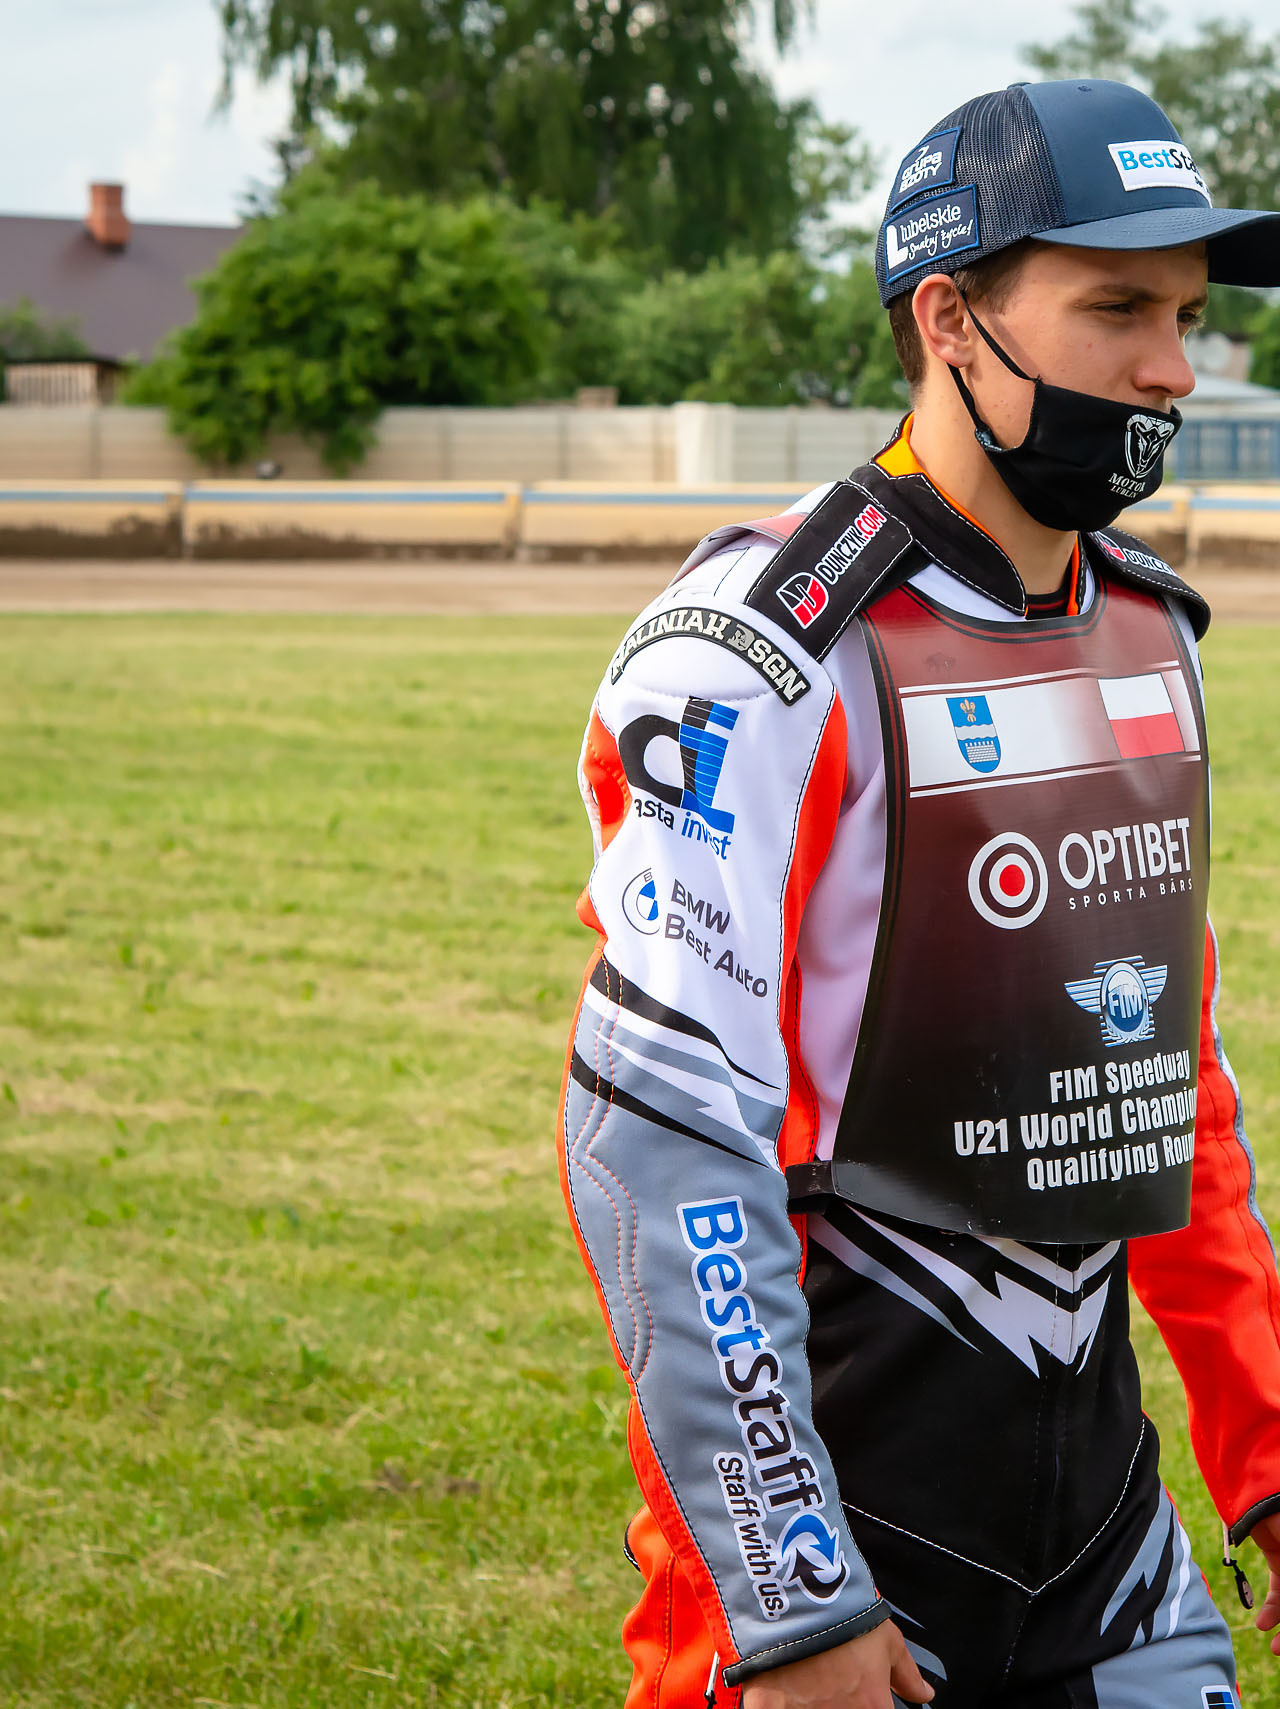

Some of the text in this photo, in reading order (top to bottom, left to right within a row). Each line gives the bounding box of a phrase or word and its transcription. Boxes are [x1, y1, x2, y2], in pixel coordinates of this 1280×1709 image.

[1118, 148, 1200, 175] BestSta
[815, 504, 887, 585] DUNCZYK.COM
[634, 798, 674, 831] asta
[1058, 817, 1191, 890] OPTIBET
[671, 878, 731, 935] BMW
[1068, 886, 1147, 910] SPORTA
[664, 913, 768, 998] Best Auto
[1108, 984, 1143, 1019] FIM
[1050, 1050, 1191, 1103] FIM Speedway
[954, 1118, 1009, 1156] U21
[1019, 1103, 1114, 1151] World
[1026, 1127, 1196, 1192] Qualifying Roun
[681, 1199, 824, 1508] BestStaff
[717, 1456, 784, 1618] Staff with us.
